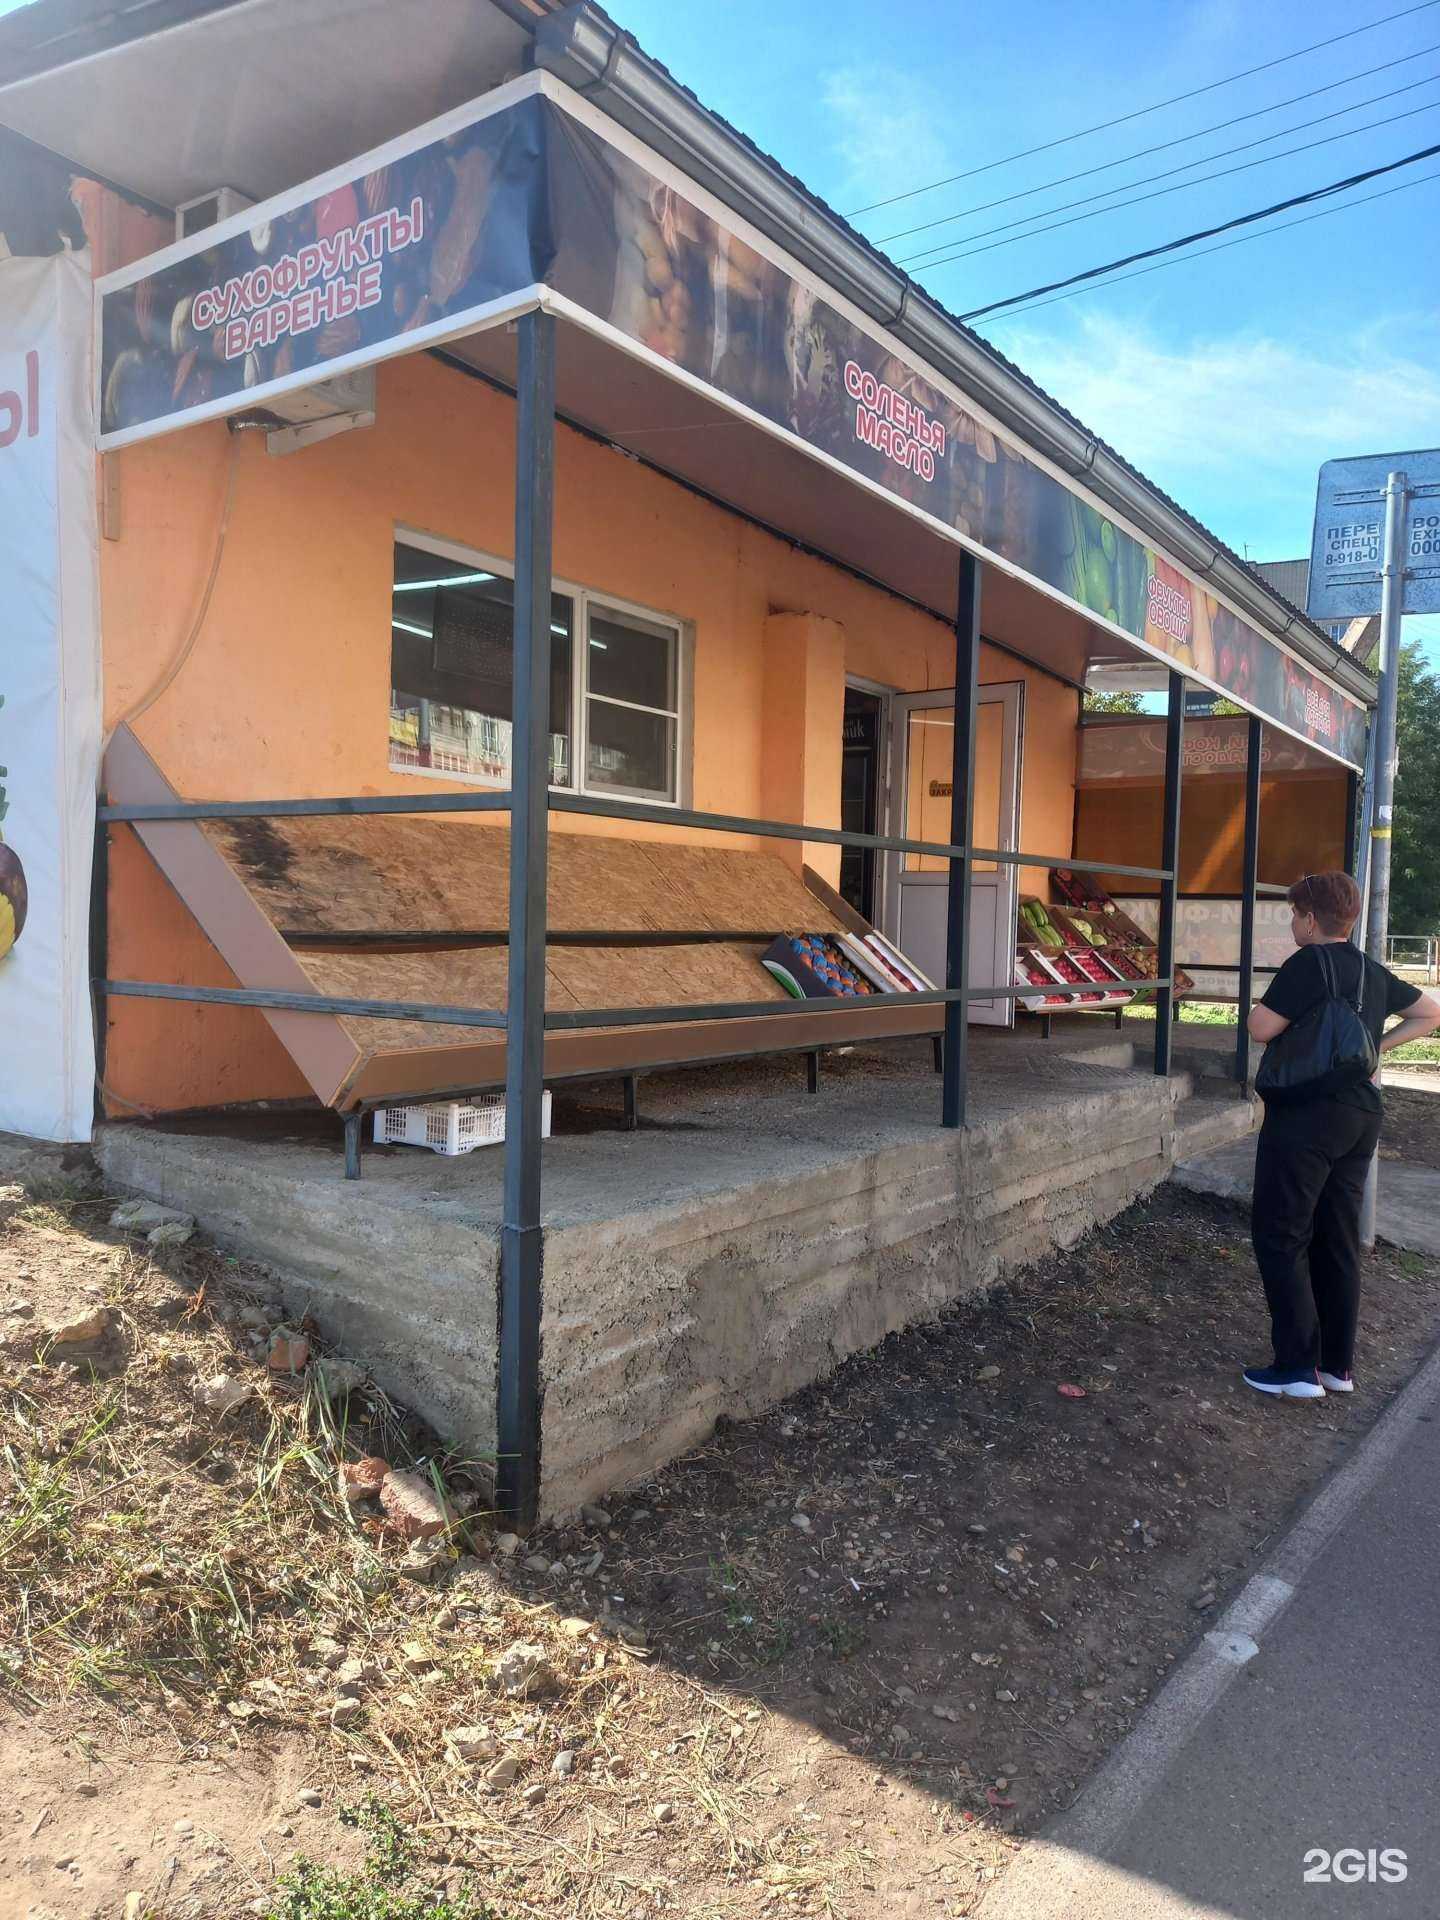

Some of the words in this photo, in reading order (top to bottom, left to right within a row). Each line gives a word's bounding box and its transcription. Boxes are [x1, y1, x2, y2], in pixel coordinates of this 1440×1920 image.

[192, 196, 423, 331] СУХОФРУКТЫ
[225, 261, 382, 360] ВАРЕНЬЕ
[844, 361, 945, 457] СОЛЕНЬЯ
[856, 403, 934, 482] МАСЛО
[1148, 575, 1190, 622] ФРУКТЫ
[1149, 600, 1186, 643] ОВОЩИ
